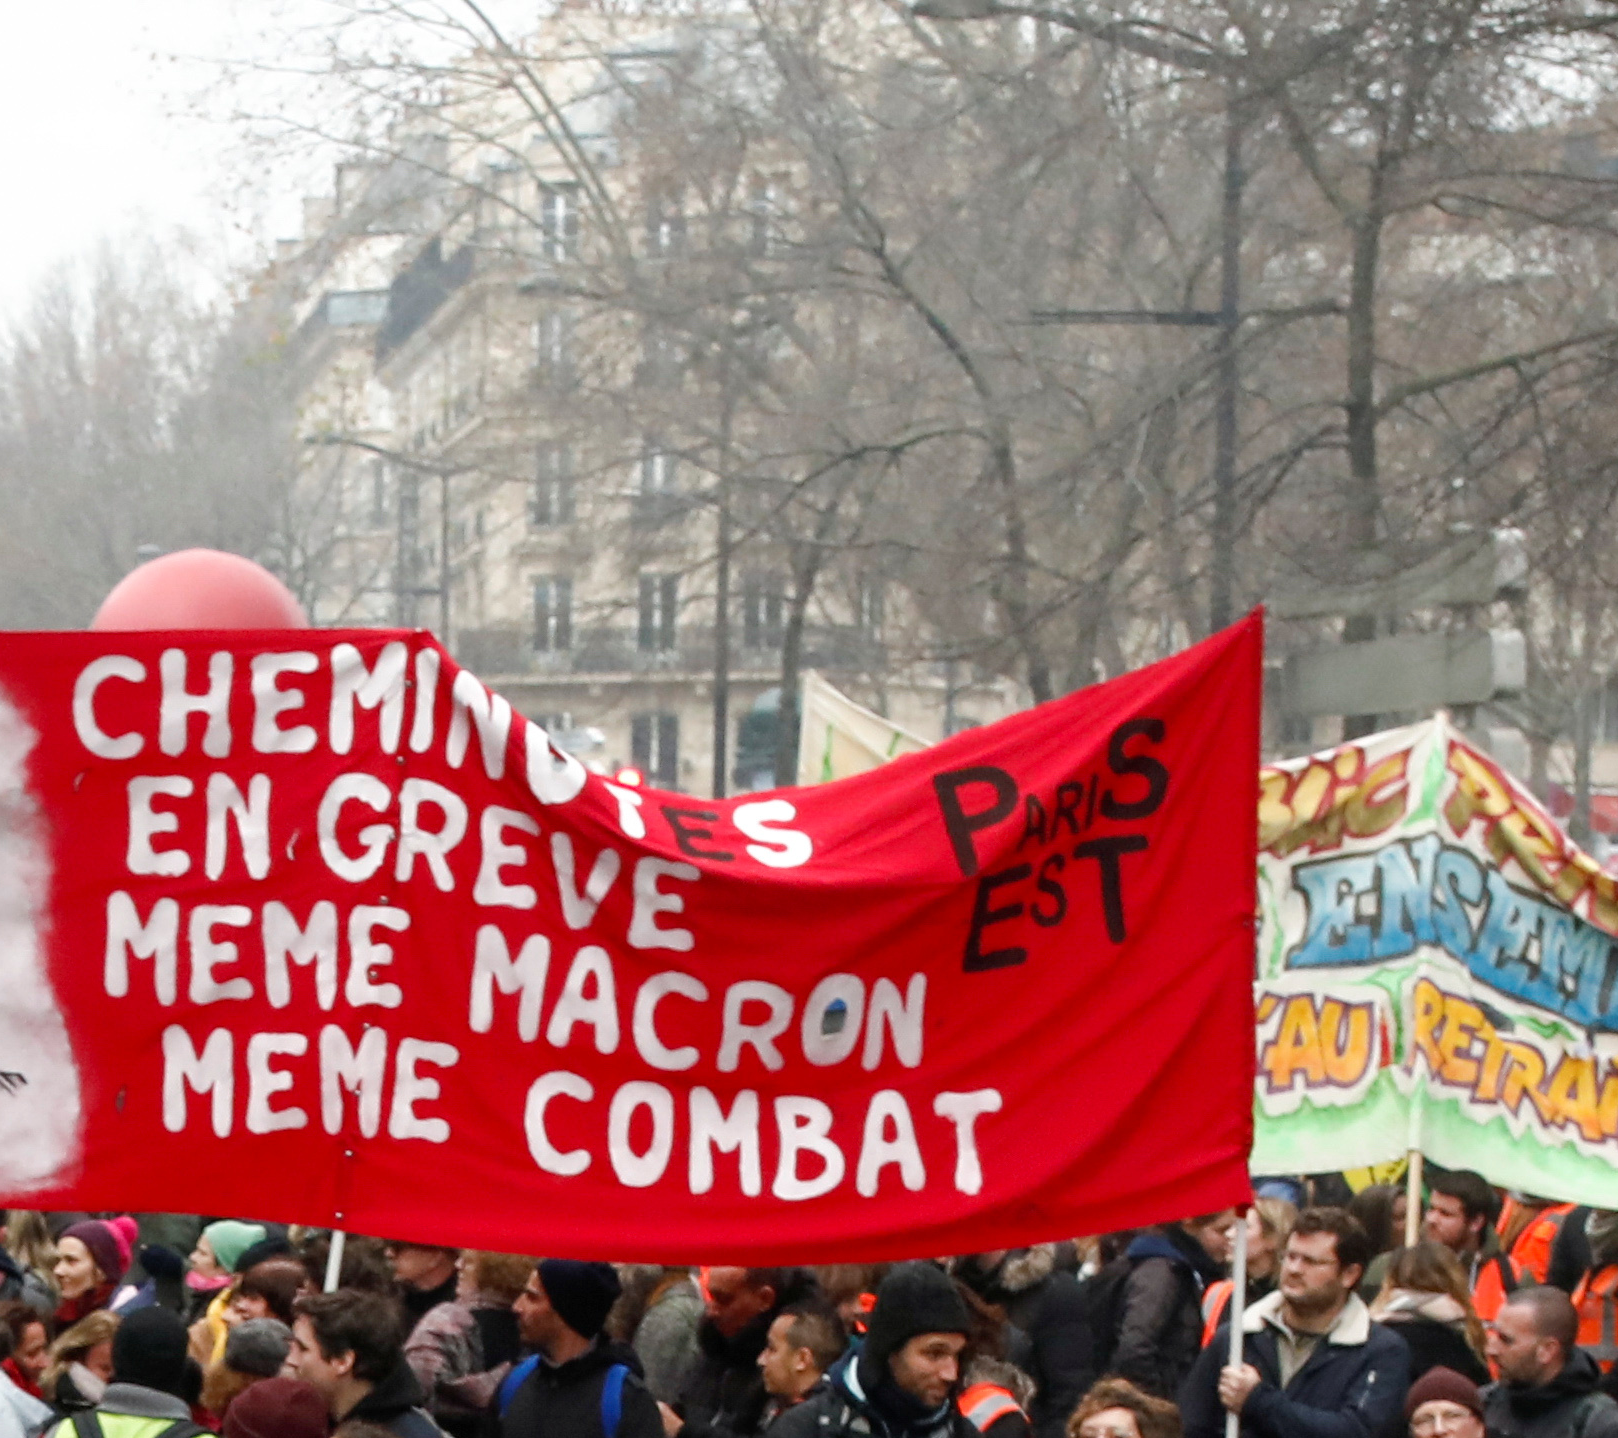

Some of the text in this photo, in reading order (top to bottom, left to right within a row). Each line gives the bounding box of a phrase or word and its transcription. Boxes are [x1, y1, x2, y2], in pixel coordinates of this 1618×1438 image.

[127, 772, 272, 881] EN
[316, 773, 700, 953] GREVE
[964, 835, 1149, 974] EST
[104, 891, 928, 1073] MEME MACRON
[162, 1025, 1003, 1202] MEME COMBAT
